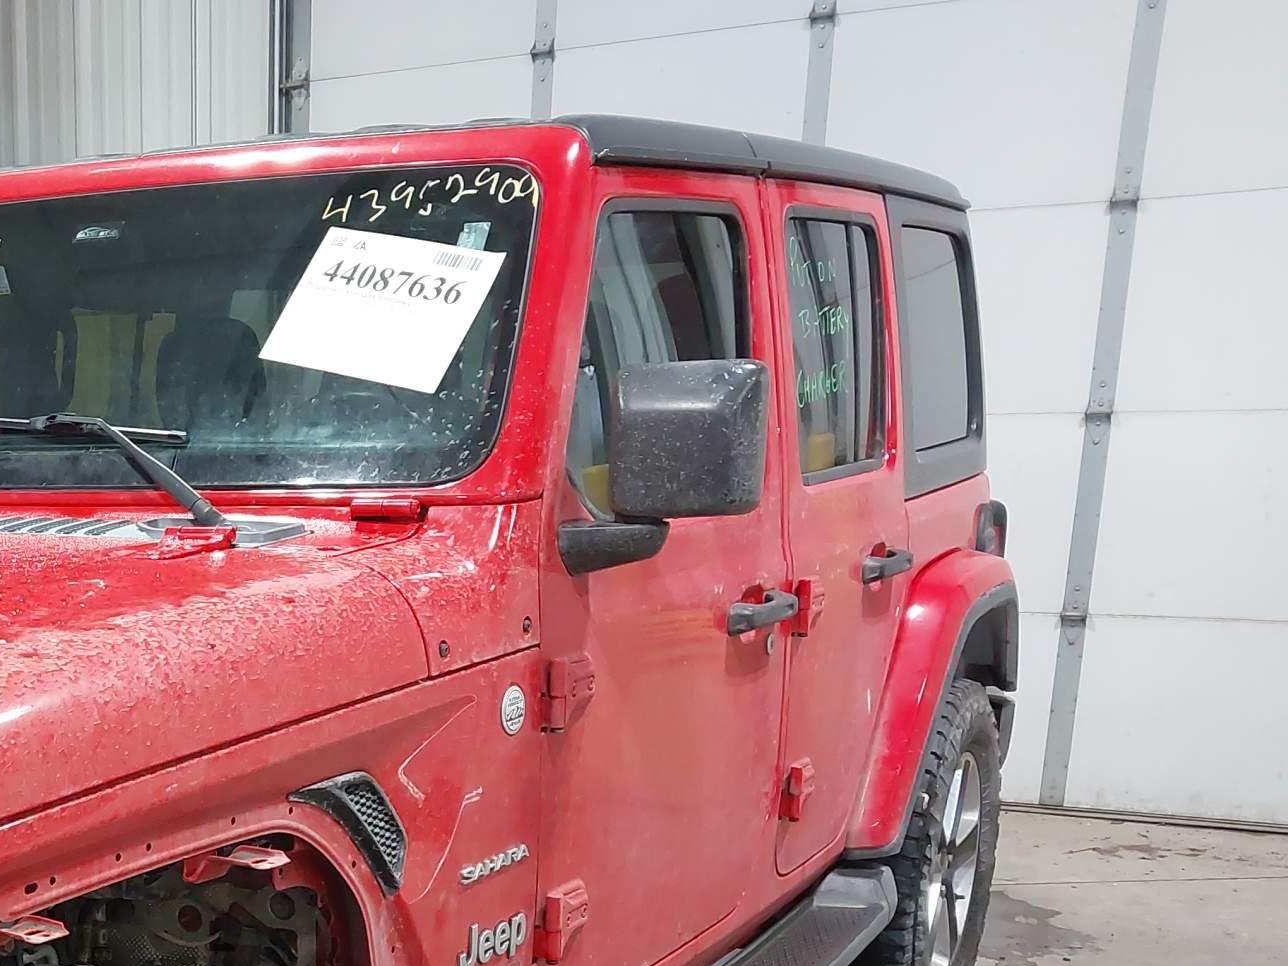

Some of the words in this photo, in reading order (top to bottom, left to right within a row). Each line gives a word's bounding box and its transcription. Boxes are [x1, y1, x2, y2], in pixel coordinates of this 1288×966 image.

[321, 167, 540, 222] 43952909
[322, 259, 468, 305] 44087636
[459, 843, 530, 886] SAHARA
